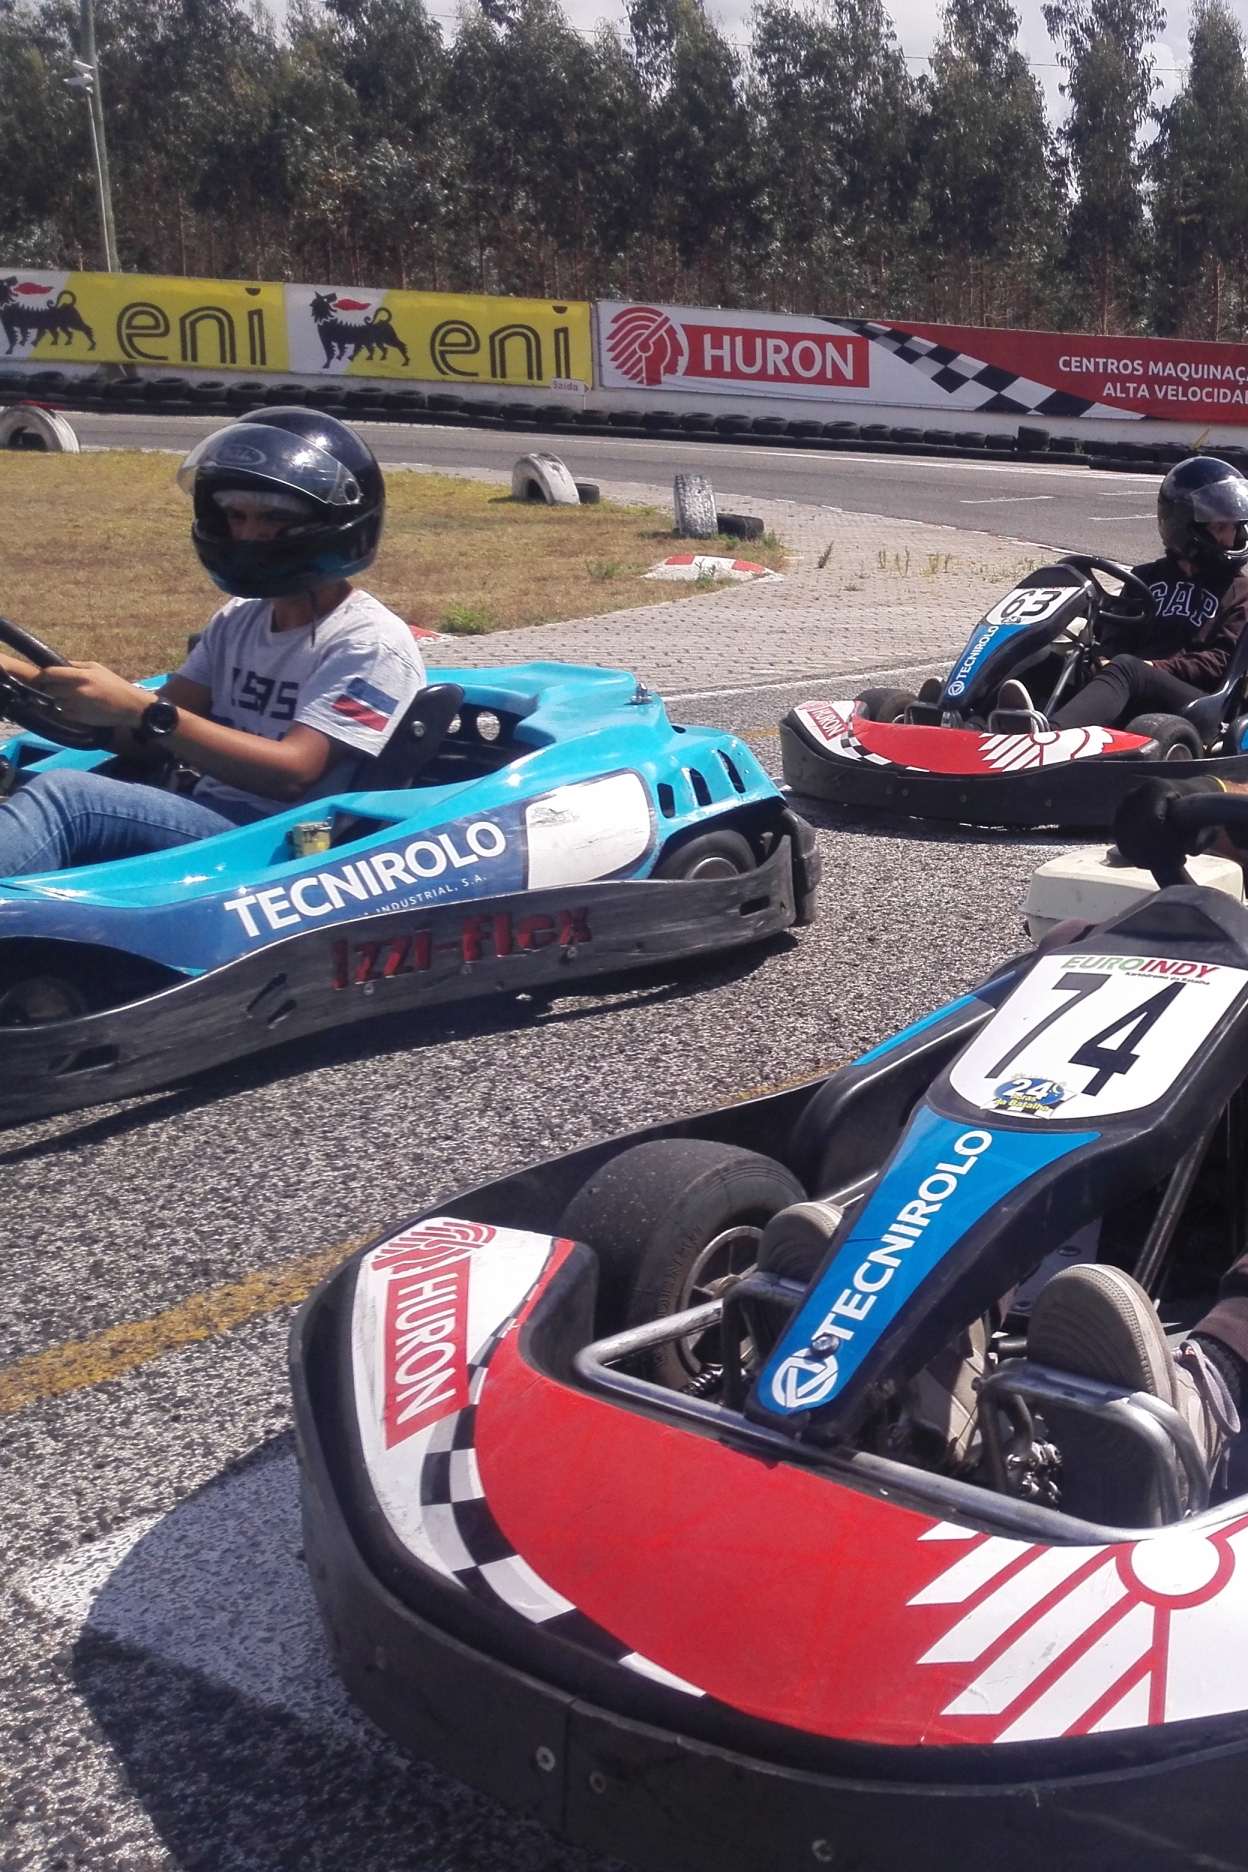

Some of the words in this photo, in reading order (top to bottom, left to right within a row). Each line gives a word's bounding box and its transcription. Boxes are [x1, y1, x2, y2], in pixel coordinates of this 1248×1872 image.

[117, 287, 267, 366] eni
[430, 305, 571, 381] eni
[703, 333, 853, 381] HURON
[1059, 356, 1143, 376] CENTROS
[1103, 382, 1150, 399] ALTA
[1001, 590, 1062, 618] 63
[956, 625, 999, 681] TECNIROLO
[224, 821, 507, 938] TECNIROLO
[461, 874, 487, 888] S.A.
[1060, 956, 1221, 978] EUROINDY
[985, 972, 1187, 1097] 74
[818, 1129, 993, 1343] TECNIROLO
[395, 1273, 458, 1425] HURON
